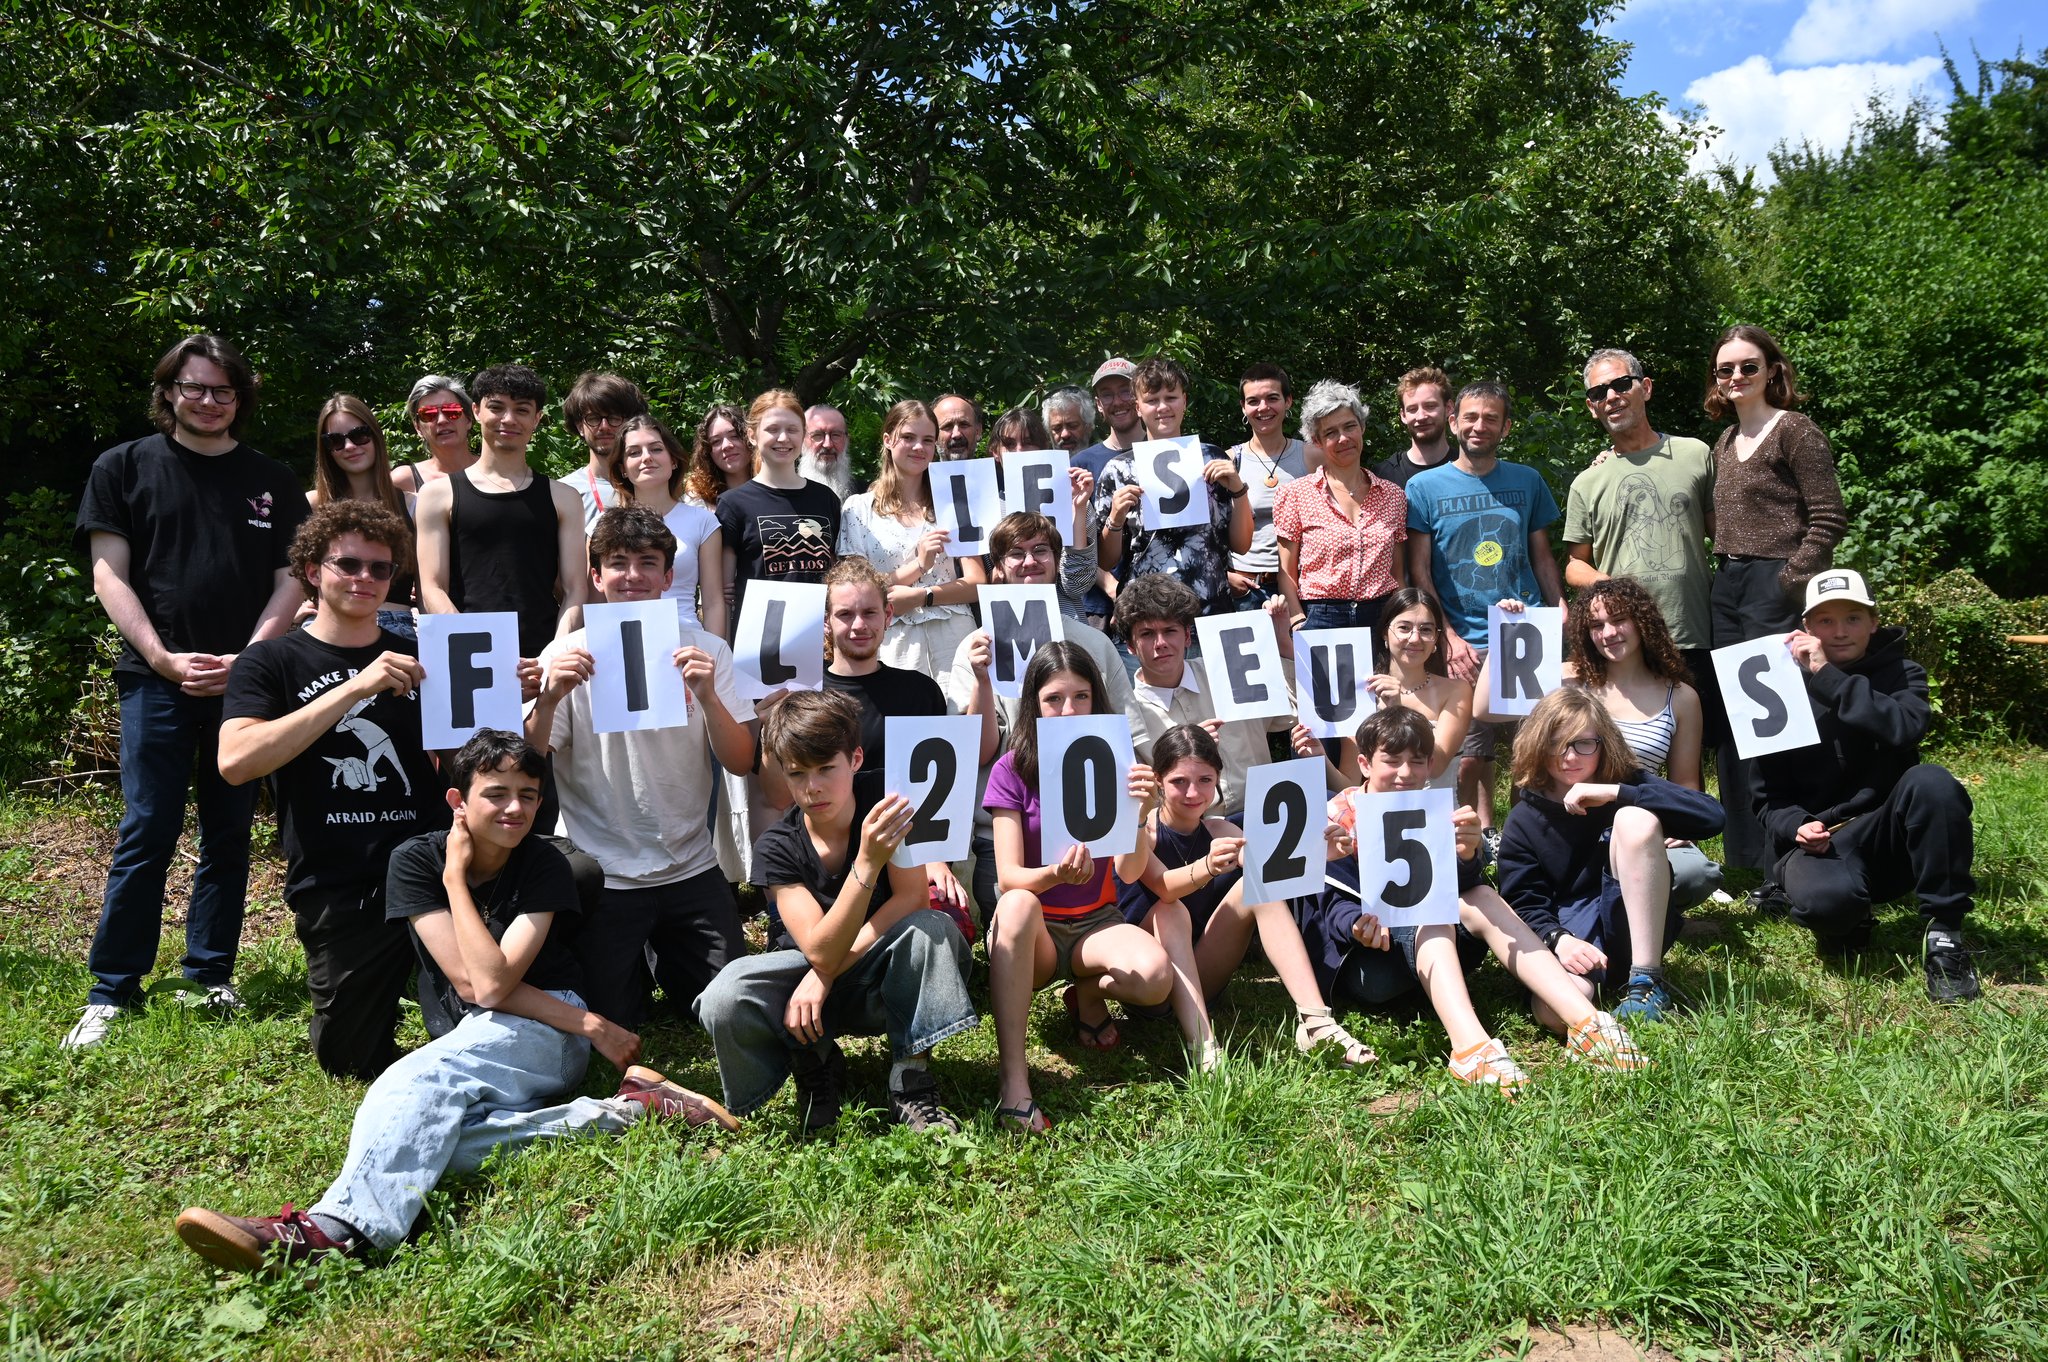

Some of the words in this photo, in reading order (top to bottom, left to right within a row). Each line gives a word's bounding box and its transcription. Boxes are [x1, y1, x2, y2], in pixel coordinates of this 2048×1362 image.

[950, 474, 984, 542] L
[1022, 463, 1056, 527] E
[1153, 449, 1190, 514] S
[1442, 496, 1472, 514] PLAY
[1475, 494, 1487, 509] IT
[1488, 491, 1526, 508] LOUD!
[768, 560, 796, 573] GET
[799, 559, 828, 571] LOS
[448, 632, 493, 729] F
[621, 620, 648, 713] I
[760, 599, 797, 685] L
[991, 600, 1053, 682] M
[1219, 626, 1268, 704] E
[1500, 622, 1543, 700] R
[297, 670, 344, 703] MAKE
[1310, 643, 1356, 722] U
[1737, 652, 1788, 738] S
[326, 812, 376, 824] AFRAID
[380, 809, 417, 822] AGAIN
[905, 737, 957, 847] 2
[1062, 736, 1118, 843] 0
[1263, 781, 1308, 884] 2
[1381, 809, 1433, 908] 5
